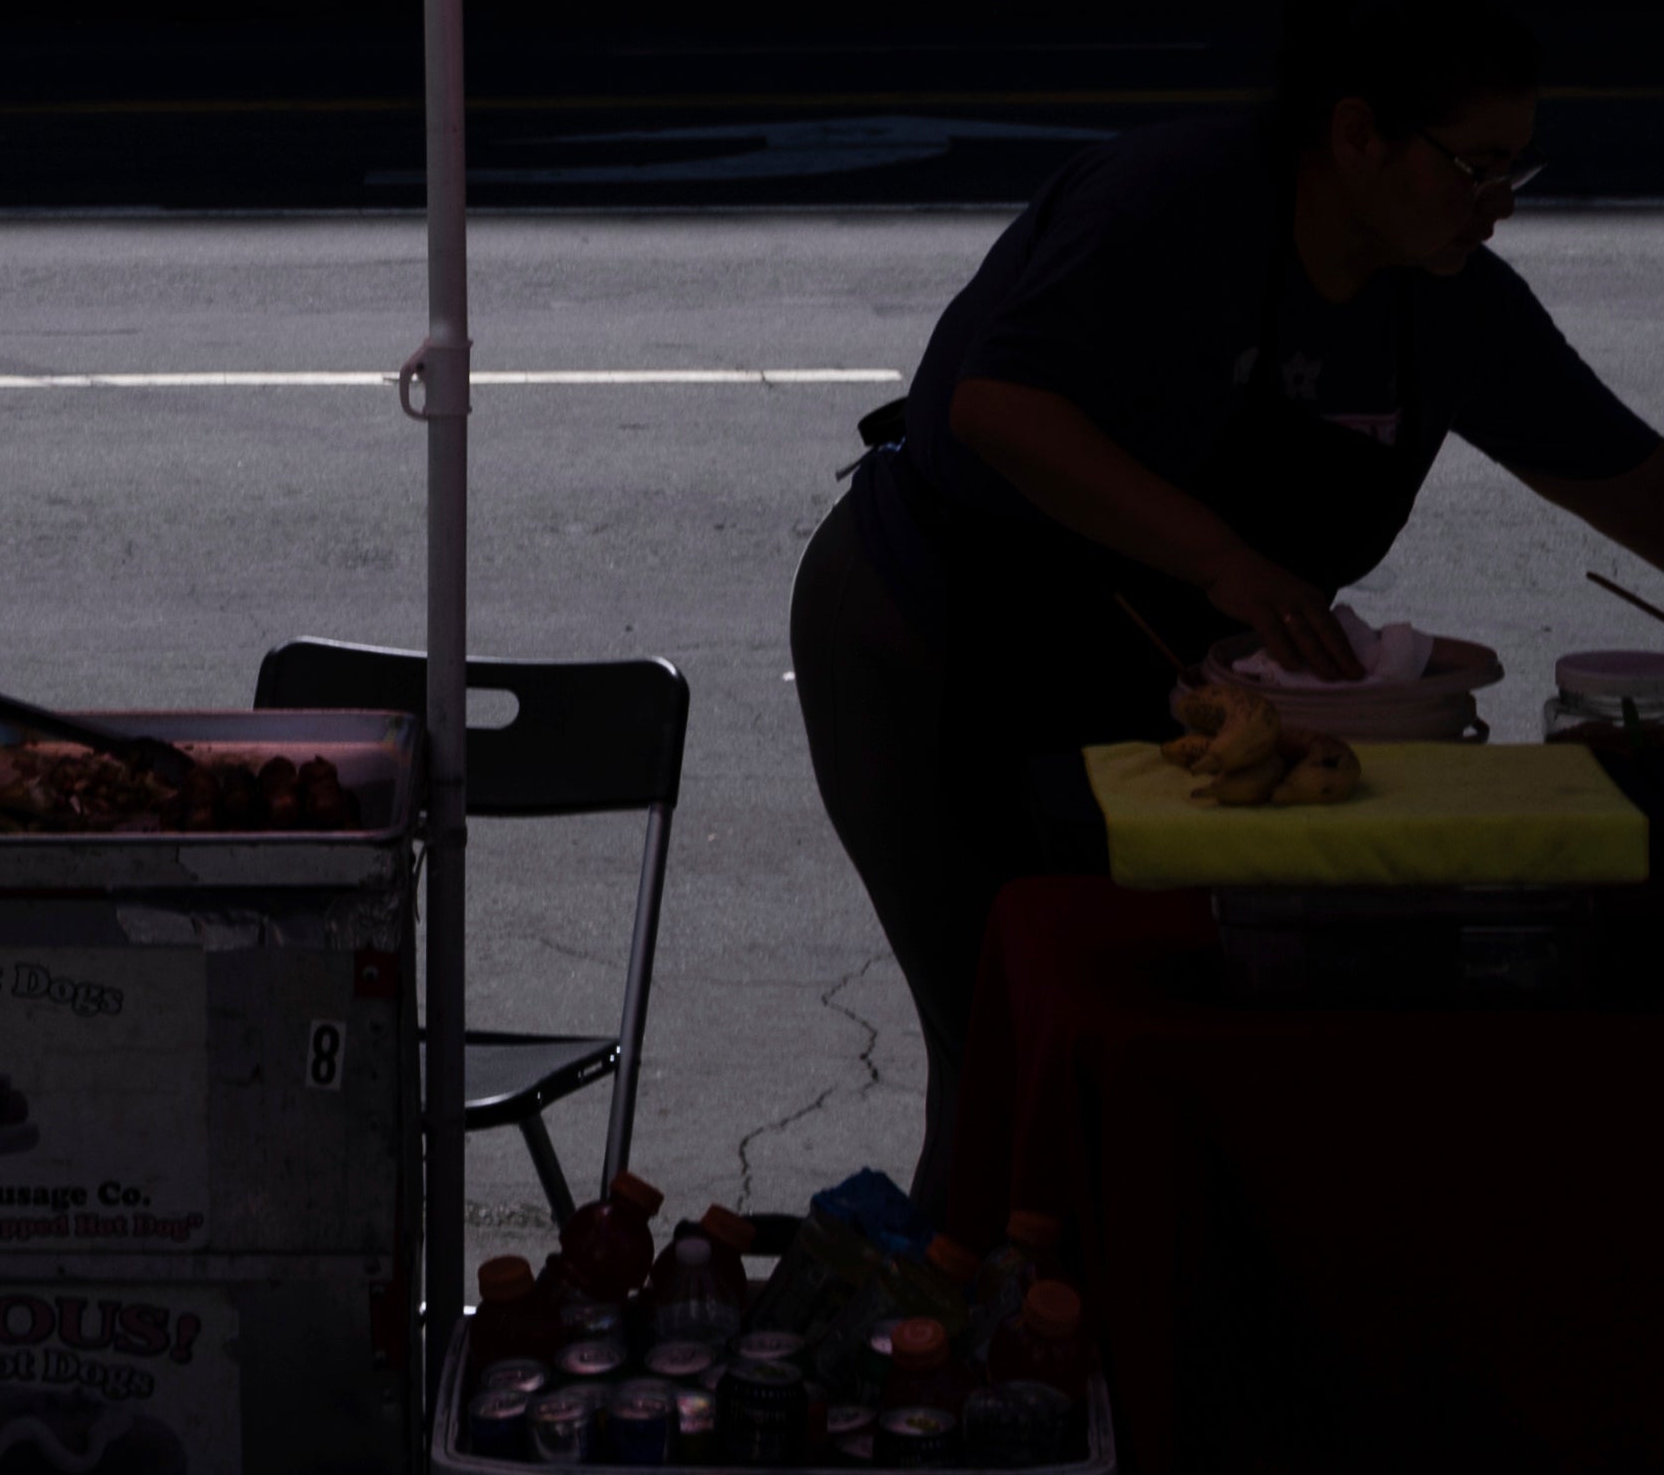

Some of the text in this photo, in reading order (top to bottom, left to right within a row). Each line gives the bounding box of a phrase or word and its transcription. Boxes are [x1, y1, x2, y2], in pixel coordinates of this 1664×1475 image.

[12, 962, 124, 1016] Dogs
[312, 1024, 340, 1084] 8
[98, 1181, 151, 1206] Co.
[74, 1212, 128, 1237] Hot
[40, 1348, 155, 1400] Dogs
